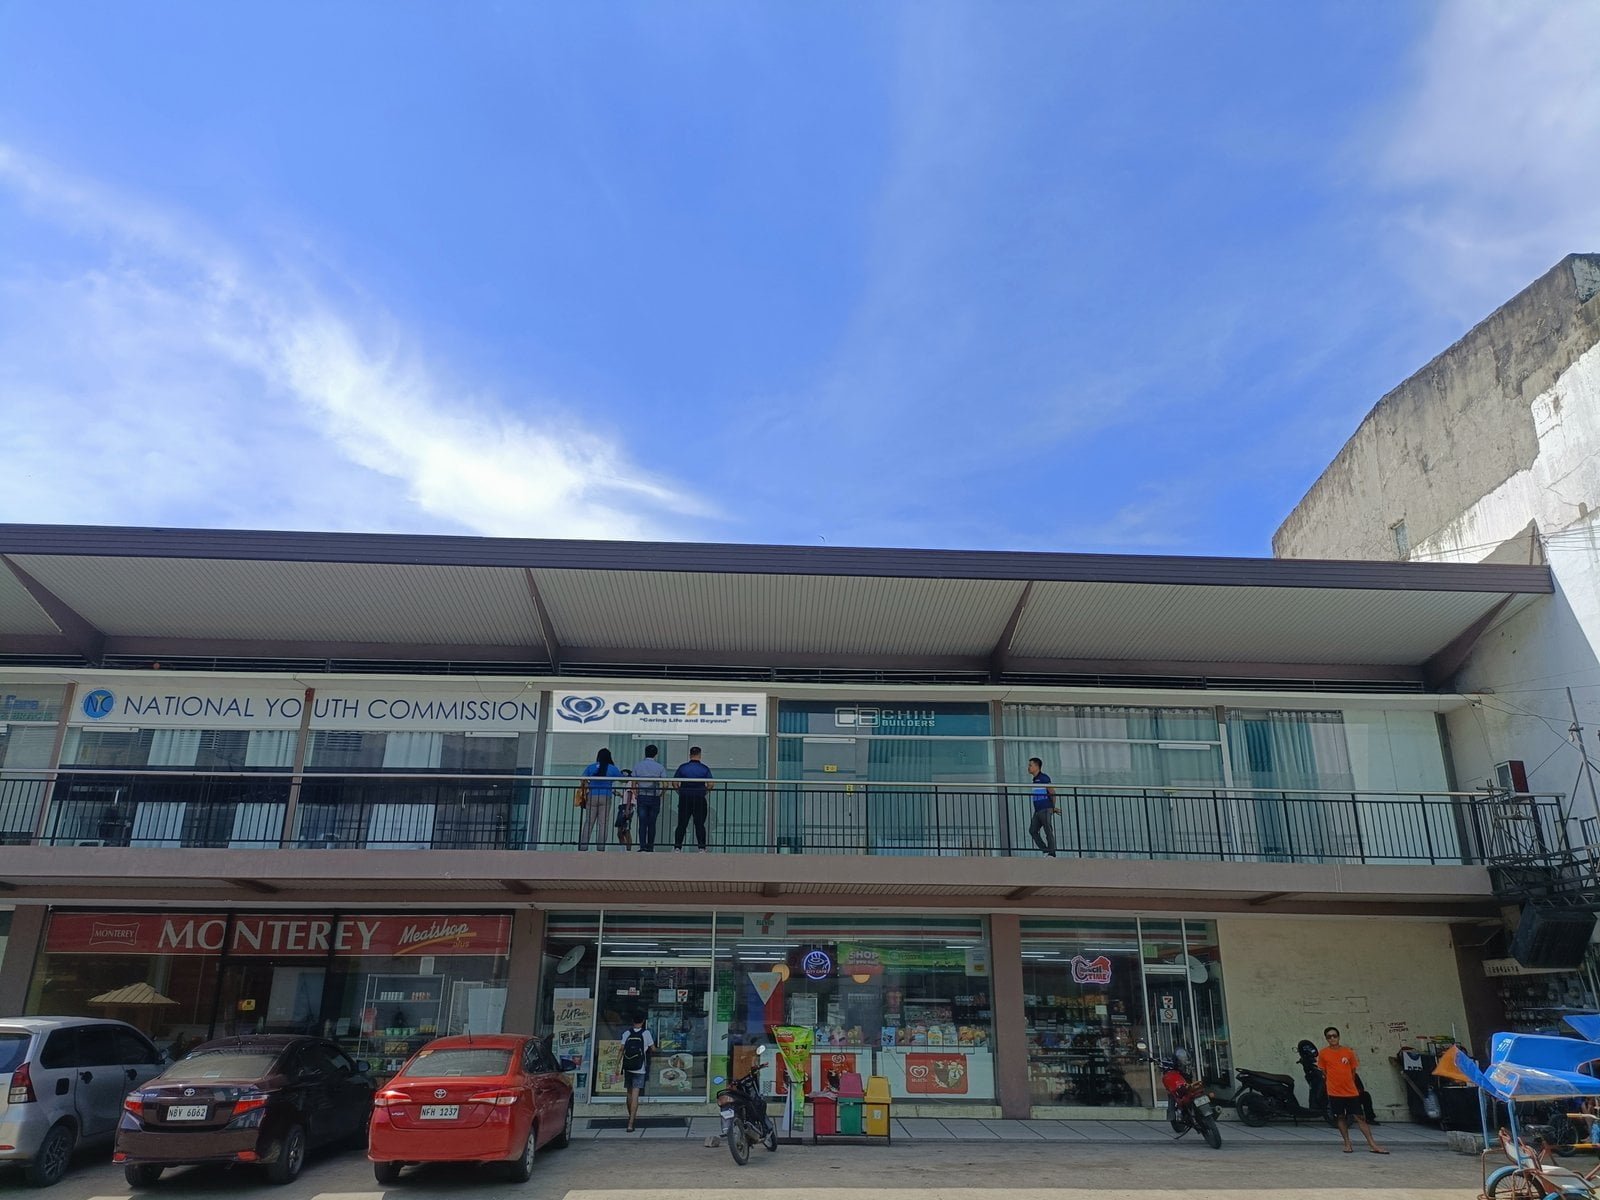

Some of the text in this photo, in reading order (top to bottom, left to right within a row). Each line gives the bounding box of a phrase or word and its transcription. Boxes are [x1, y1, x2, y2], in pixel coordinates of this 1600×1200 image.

[124, 696, 538, 720] NATIONAL YOUTH COMMISSION
[613, 702, 757, 716] CARE2LIFE
[882, 710, 935, 720] CHIU
[94, 929, 134, 938] MONTEREY
[157, 919, 381, 950] MONTEREY
[398, 919, 469, 945] Meatshop
[849, 951, 879, 960] SHOP
[421, 1108, 458, 1117] NFH 1237
